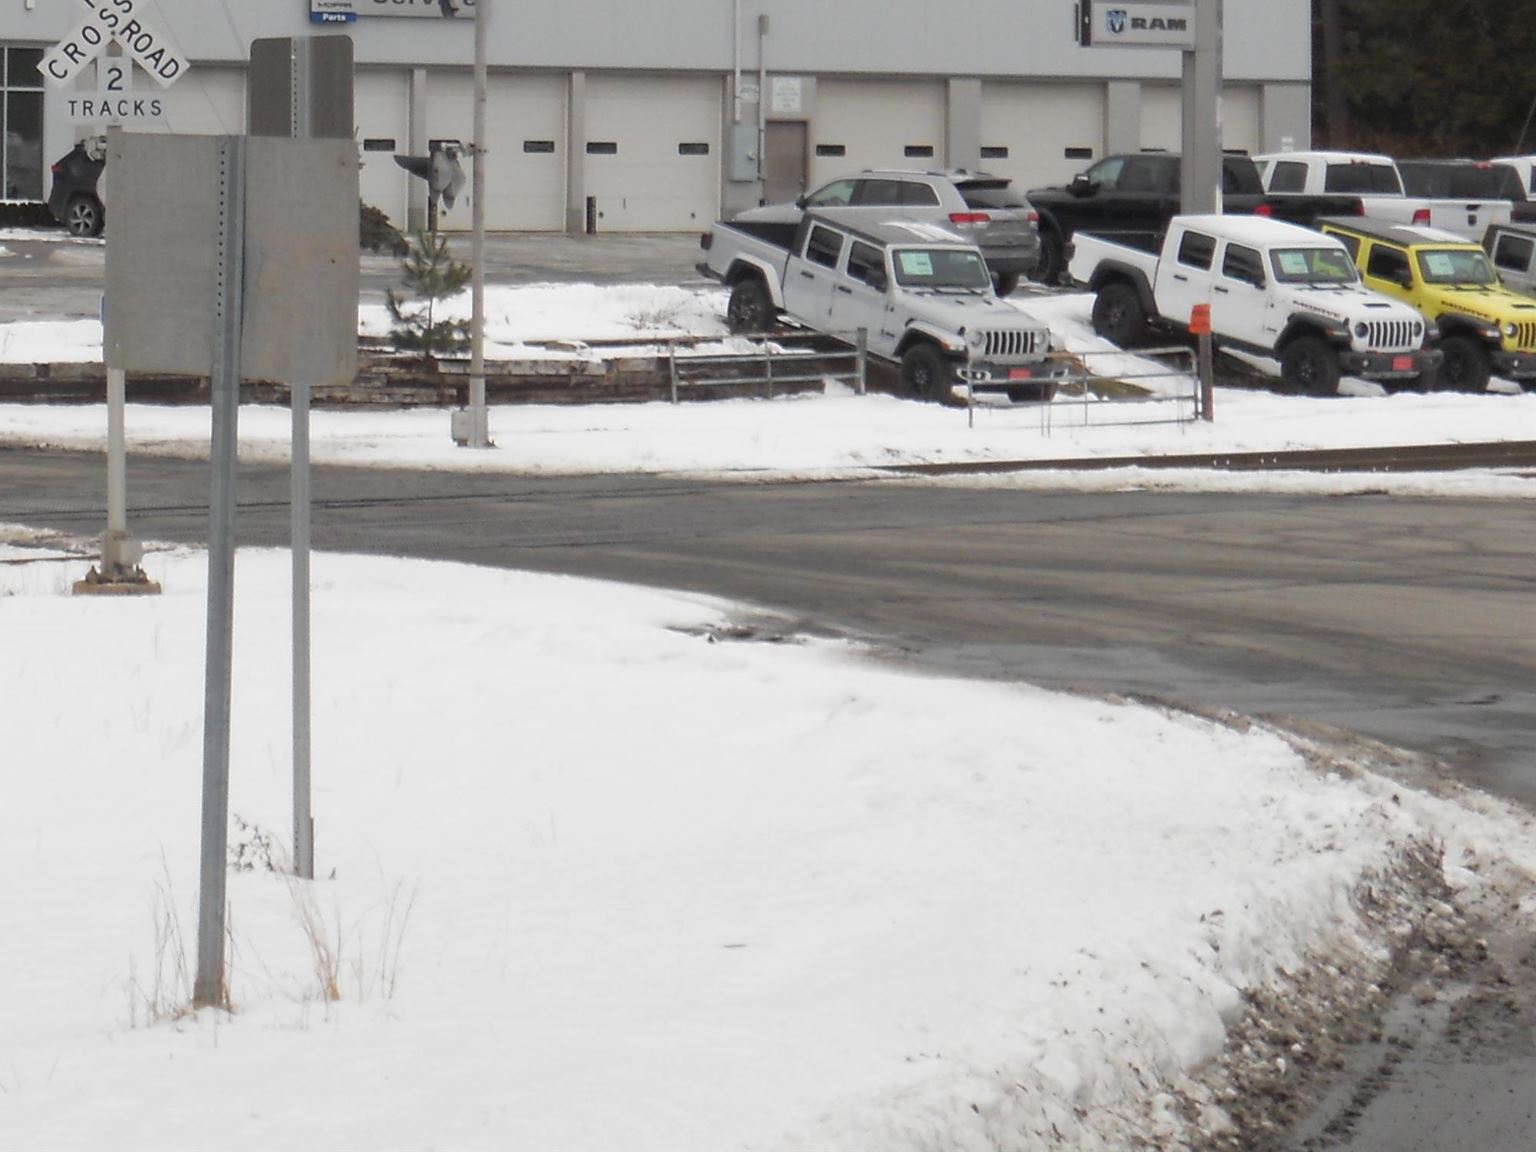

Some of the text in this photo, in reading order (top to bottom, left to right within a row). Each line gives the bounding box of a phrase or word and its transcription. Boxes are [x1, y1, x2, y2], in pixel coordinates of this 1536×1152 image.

[322, 13, 347, 22] Parts
[1131, 17, 1187, 31] RAM
[107, 67, 124, 92] 2
[67, 99, 162, 117] TRACKS
